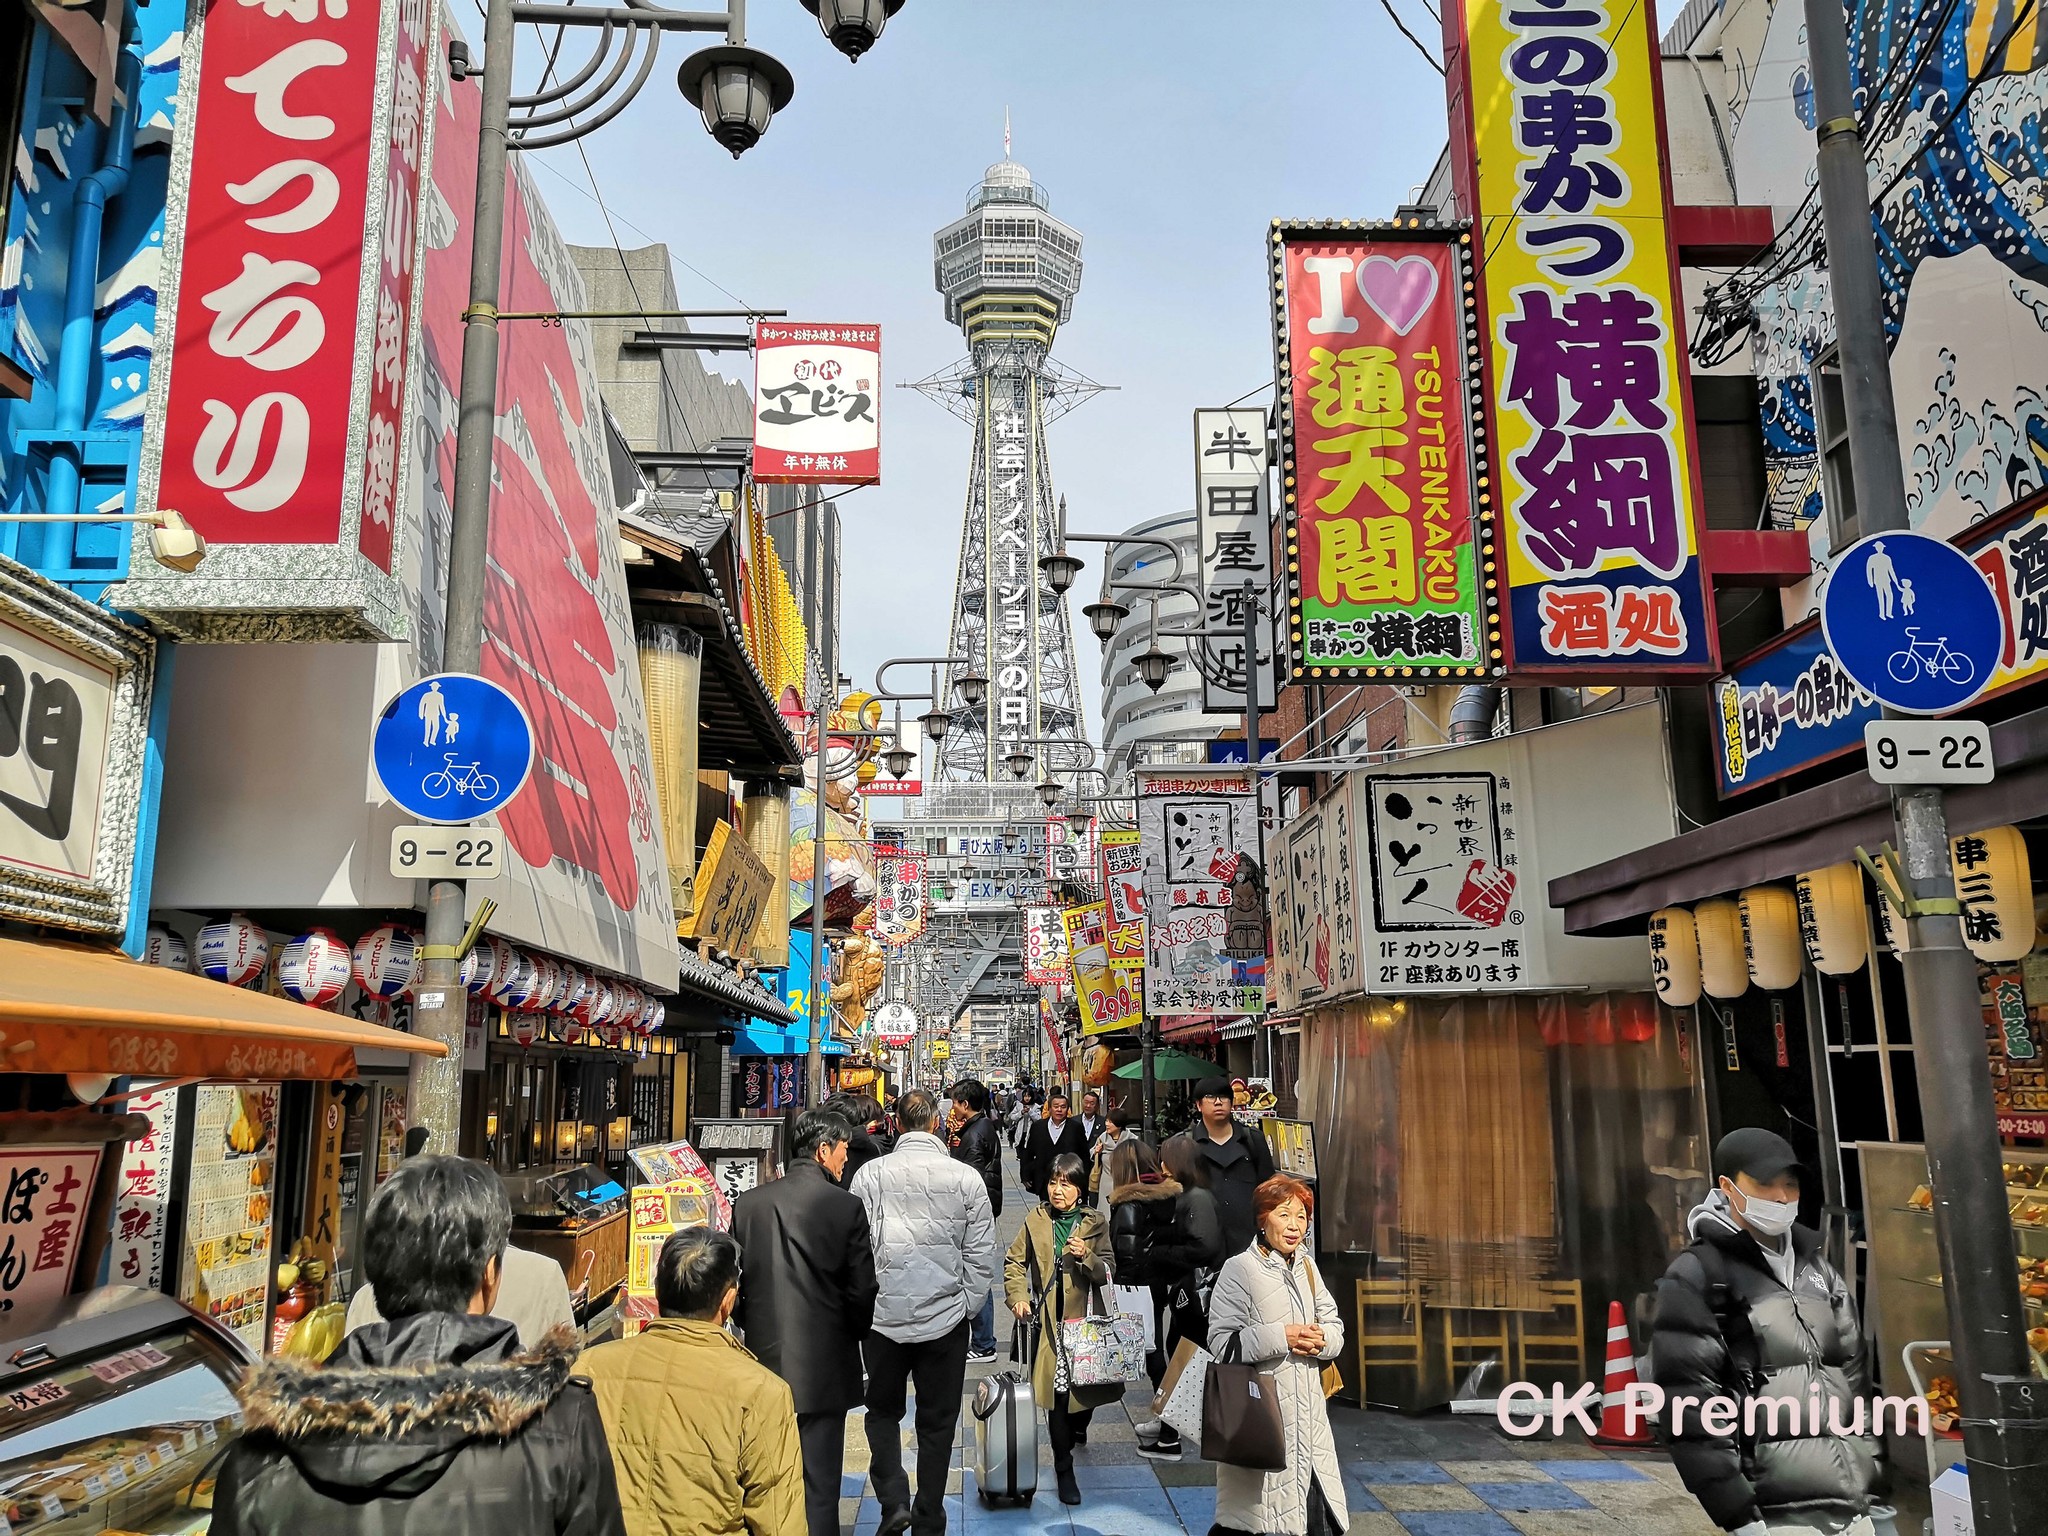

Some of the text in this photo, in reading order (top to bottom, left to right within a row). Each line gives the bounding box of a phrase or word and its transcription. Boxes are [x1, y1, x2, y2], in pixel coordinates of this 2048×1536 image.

[783, 455, 848, 470] 年中無休
[1308, 345, 1416, 605] 通天閣
[1410, 345, 1459, 600] TSUTENKAKU
[1204, 425, 1267, 686] 半田屋酒店
[1308, 621, 1366, 637] 日本一の
[1366, 612, 1463, 658] 横綱
[1546, 590, 1684, 648] 酒処
[1309, 639, 1366, 656] 串かつ
[1744, 658, 1876, 753] 日本一の串か
[1722, 685, 1744, 776] 新世界
[1144, 779, 1250, 793] 元祖串カツ専門店
[1452, 794, 1483, 856] 新世界
[1499, 777, 1518, 866] 商標登録
[1106, 844, 1140, 861] 新世界
[897, 861, 919, 919] 串かつ
[202, 941, 224, 949] Asahi
[234, 925, 249, 967] アサヒビール
[1151, 913, 1228, 950] 大阪名物
[1404, 939, 1519, 959] カウンター席
[305, 945, 320, 987] アサヒビール
[369, 937, 386, 979] アサヒビール
[1405, 965, 1521, 984] 座敷あります
[1651, 933, 1672, 993] 串かつ
[1152, 991, 1262, 1008] 宴会予約受付中
[780, 1061, 794, 1105] 串かつ
[33, 1165, 81, 1273] 土産
